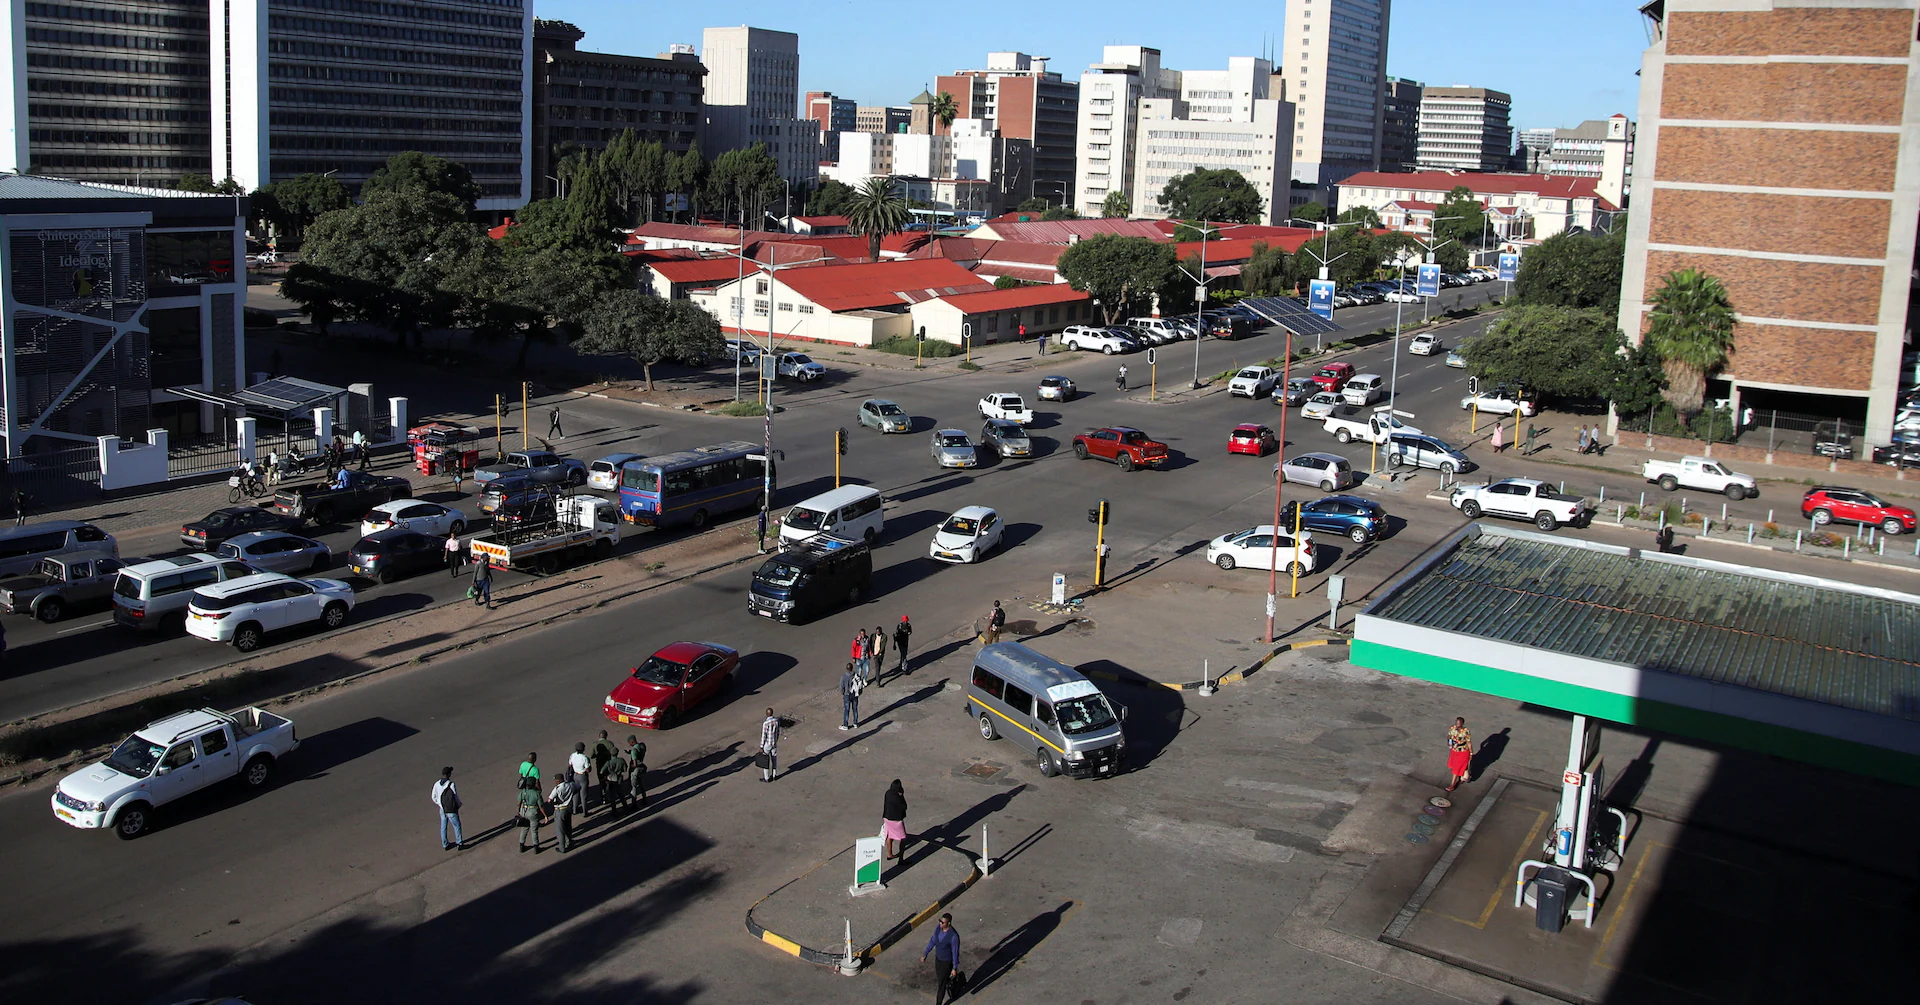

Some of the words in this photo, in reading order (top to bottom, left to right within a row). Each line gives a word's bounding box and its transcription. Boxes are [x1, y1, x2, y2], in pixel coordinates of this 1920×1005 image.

[37, 229, 82, 242] Chitepo
[84, 229, 121, 239] School
[58, 254, 112, 268] Ideology
